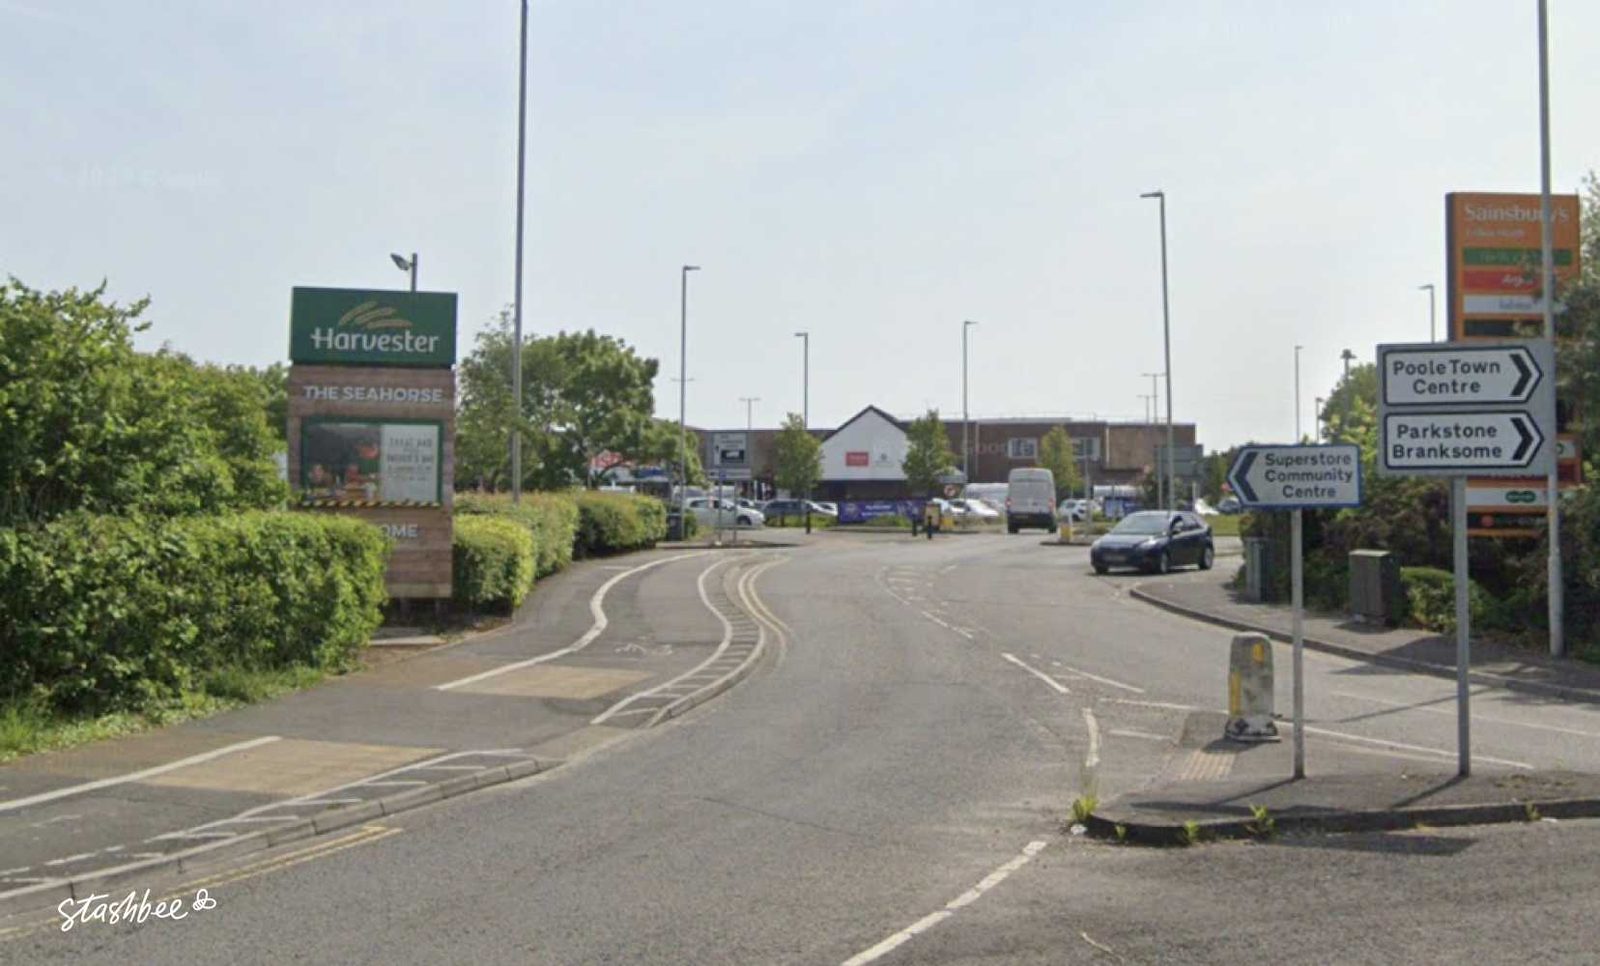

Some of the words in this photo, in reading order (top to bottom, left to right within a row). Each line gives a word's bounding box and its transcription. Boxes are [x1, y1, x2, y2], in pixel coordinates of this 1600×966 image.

[310, 326, 440, 352] Harvester
[1393, 360, 1446, 375] Poole
[1449, 359, 1500, 374] Town
[303, 385, 340, 400] THE
[342, 386, 443, 402] SEAHORSE
[1412, 379, 1481, 394] Centre
[1397, 423, 1497, 439] Parkstone
[1393, 444, 1502, 459] Branksome
[1264, 453, 1351, 467] Superstore
[1264, 468, 1352, 483] Community
[1282, 485, 1337, 498] Centre
